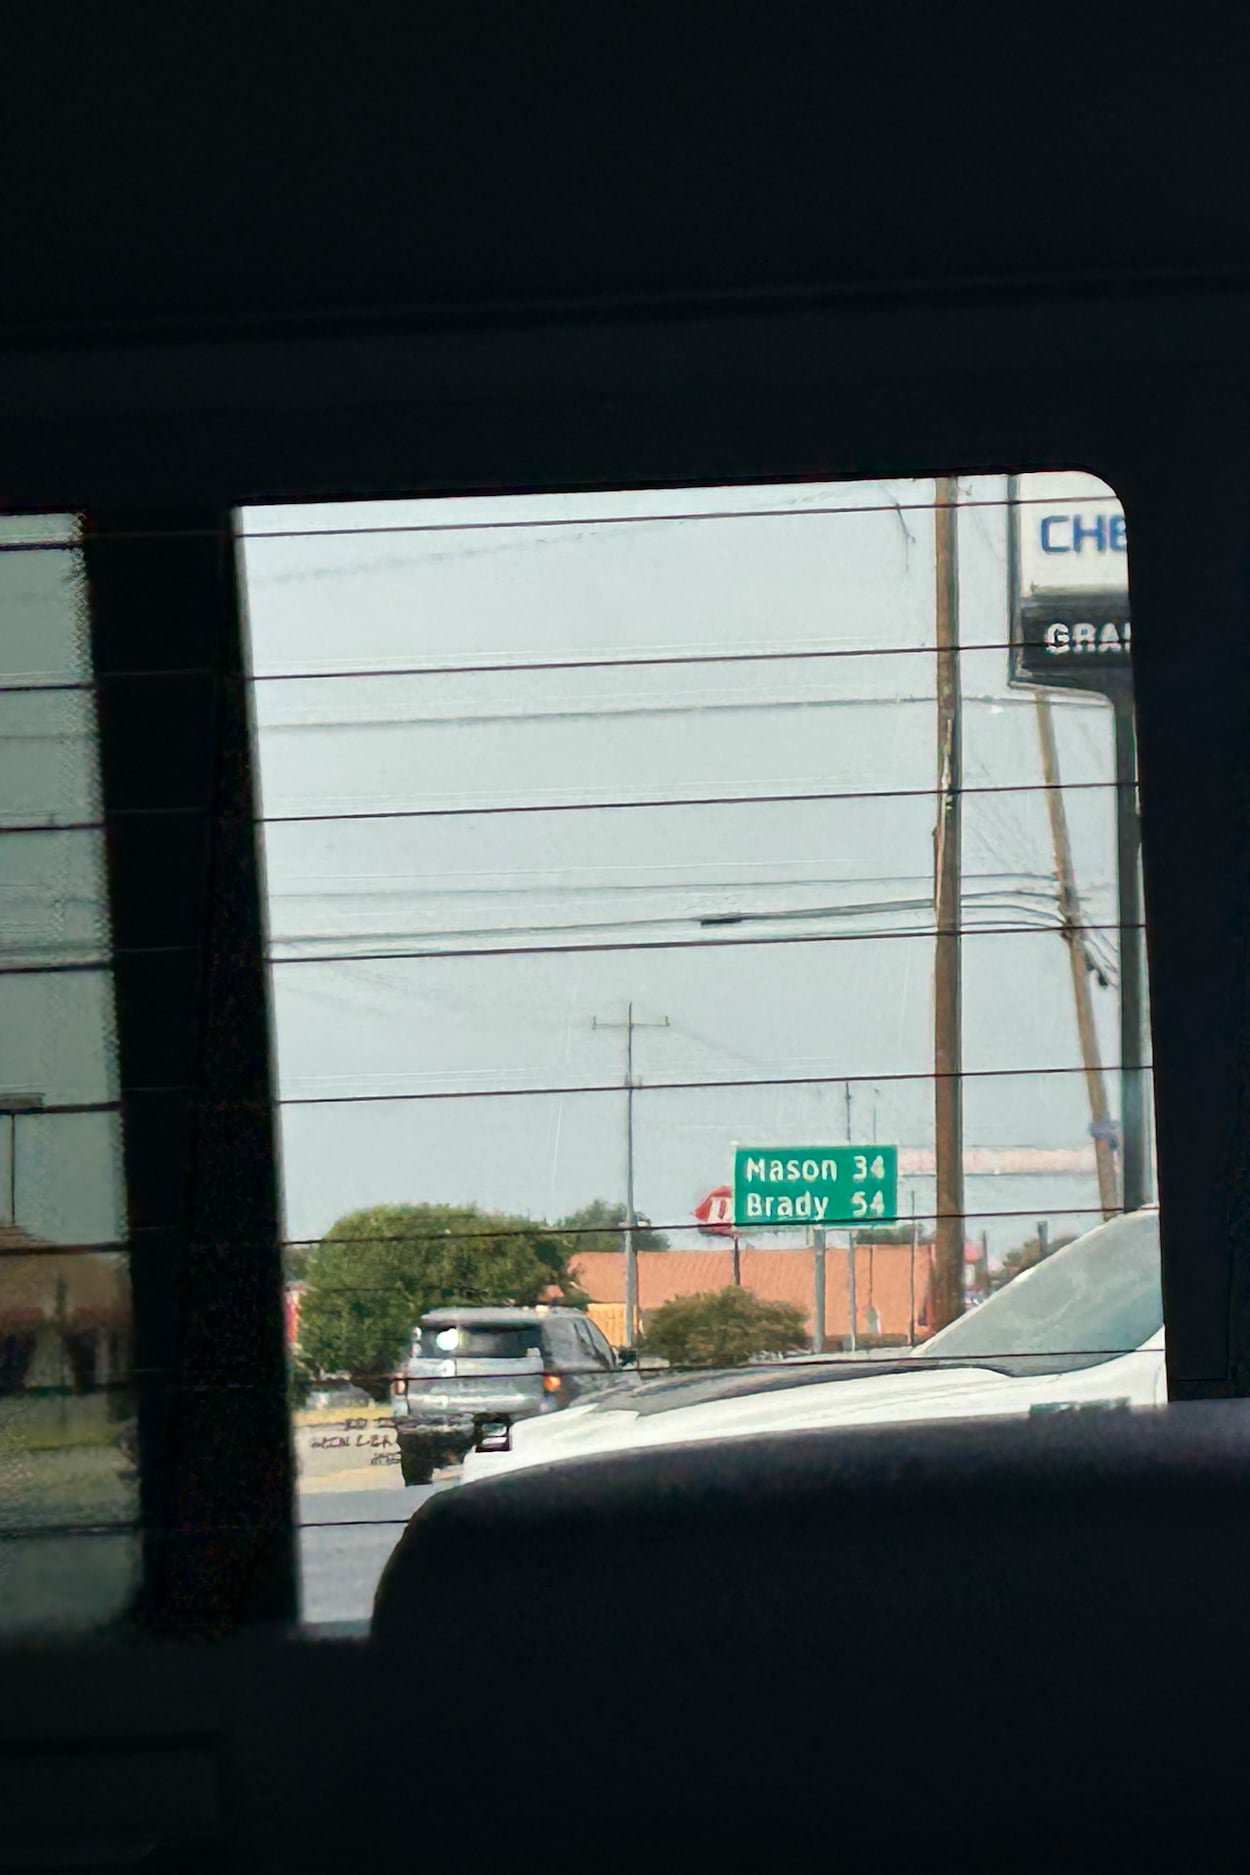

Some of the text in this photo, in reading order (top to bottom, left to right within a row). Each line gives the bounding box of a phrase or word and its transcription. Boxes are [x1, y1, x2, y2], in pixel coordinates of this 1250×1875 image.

[746, 1155, 885, 1182] Mason 34
[746, 1190, 885, 1221] Brady 54
